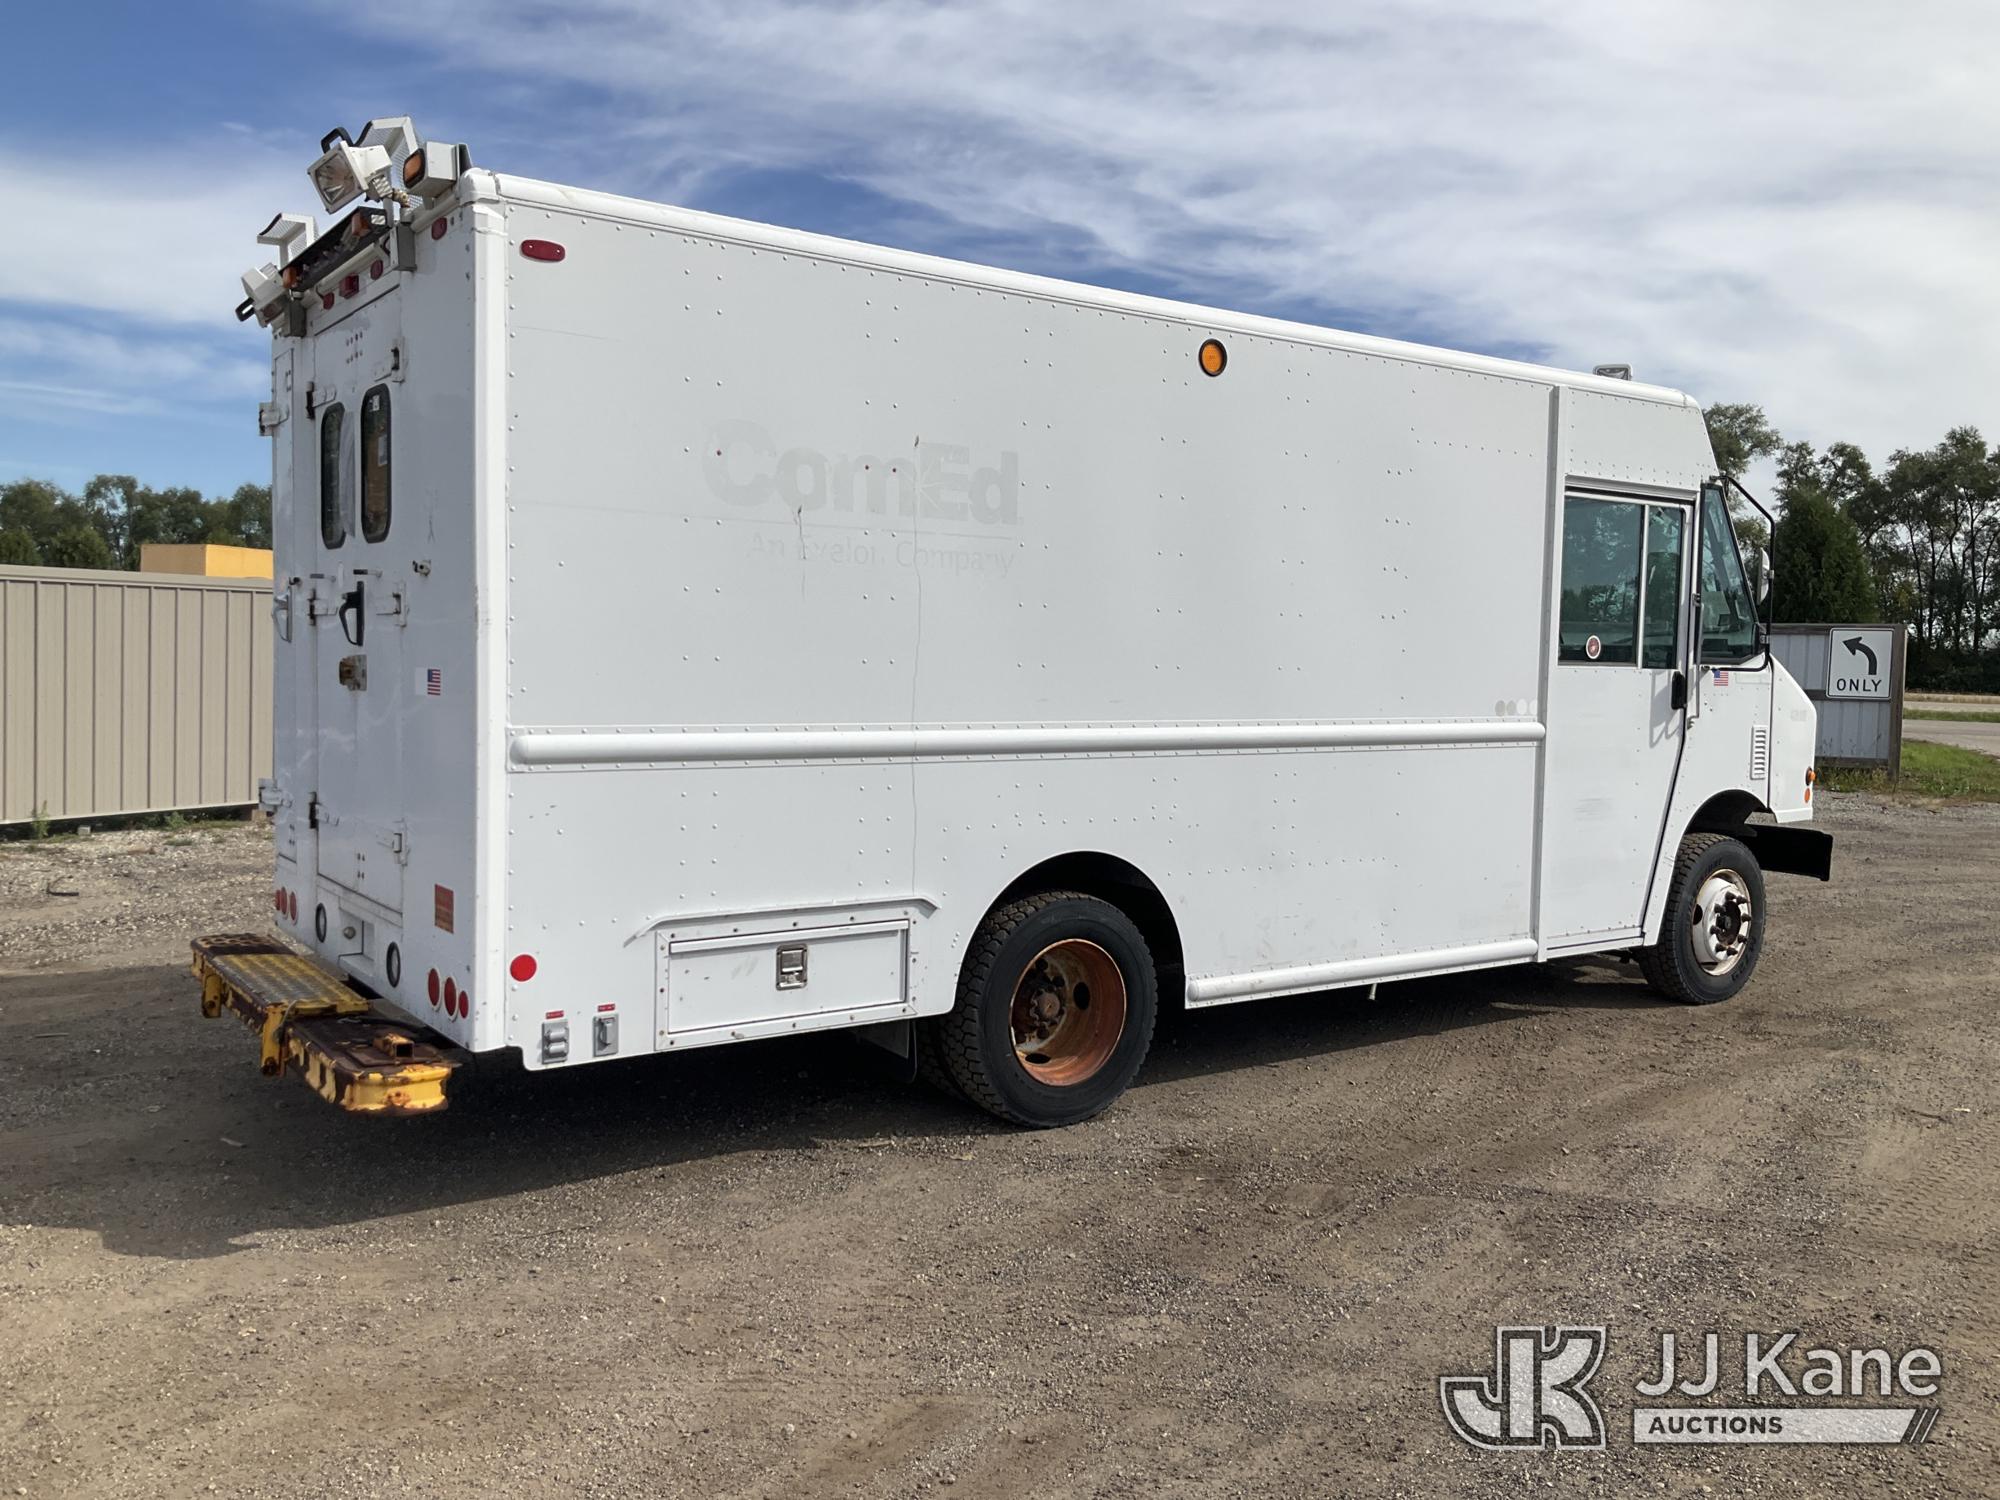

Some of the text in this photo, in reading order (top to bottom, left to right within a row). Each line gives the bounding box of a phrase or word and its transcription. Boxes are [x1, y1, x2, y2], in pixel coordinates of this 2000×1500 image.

[702, 418, 1020, 525] ComEd
[750, 532, 785, 558] An
[896, 540, 1015, 579] Company
[1836, 679, 1882, 692] ONLY
